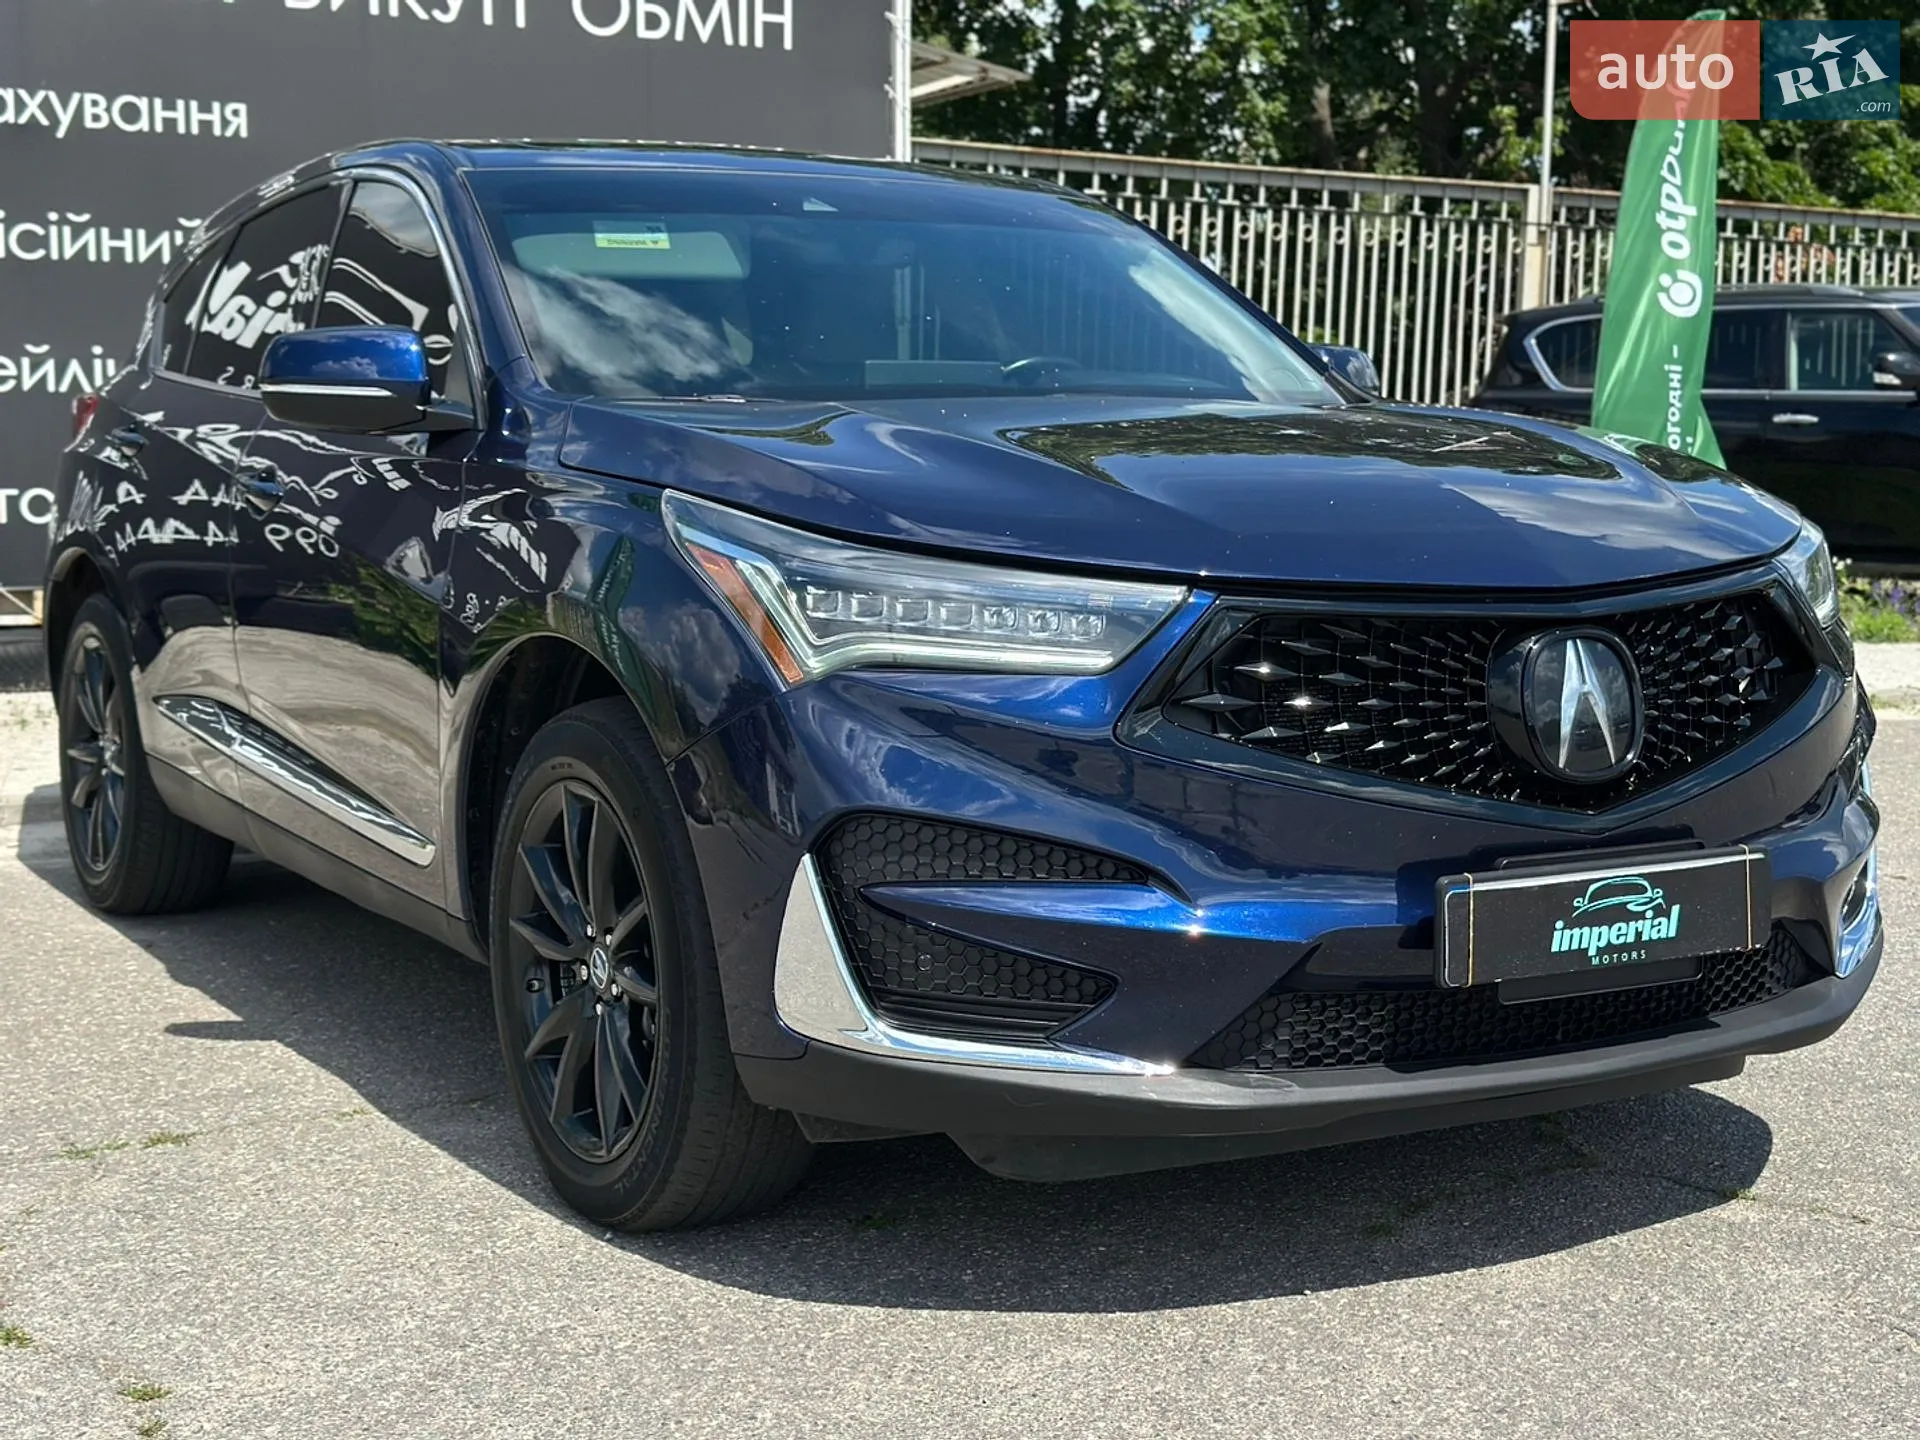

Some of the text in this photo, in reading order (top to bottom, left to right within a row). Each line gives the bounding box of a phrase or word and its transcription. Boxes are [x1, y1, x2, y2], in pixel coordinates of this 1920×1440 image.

[570, 0, 794, 50] ОБМІН
[1551, 904, 1681, 956] imperial
[1591, 949, 1647, 966] MOTORS
